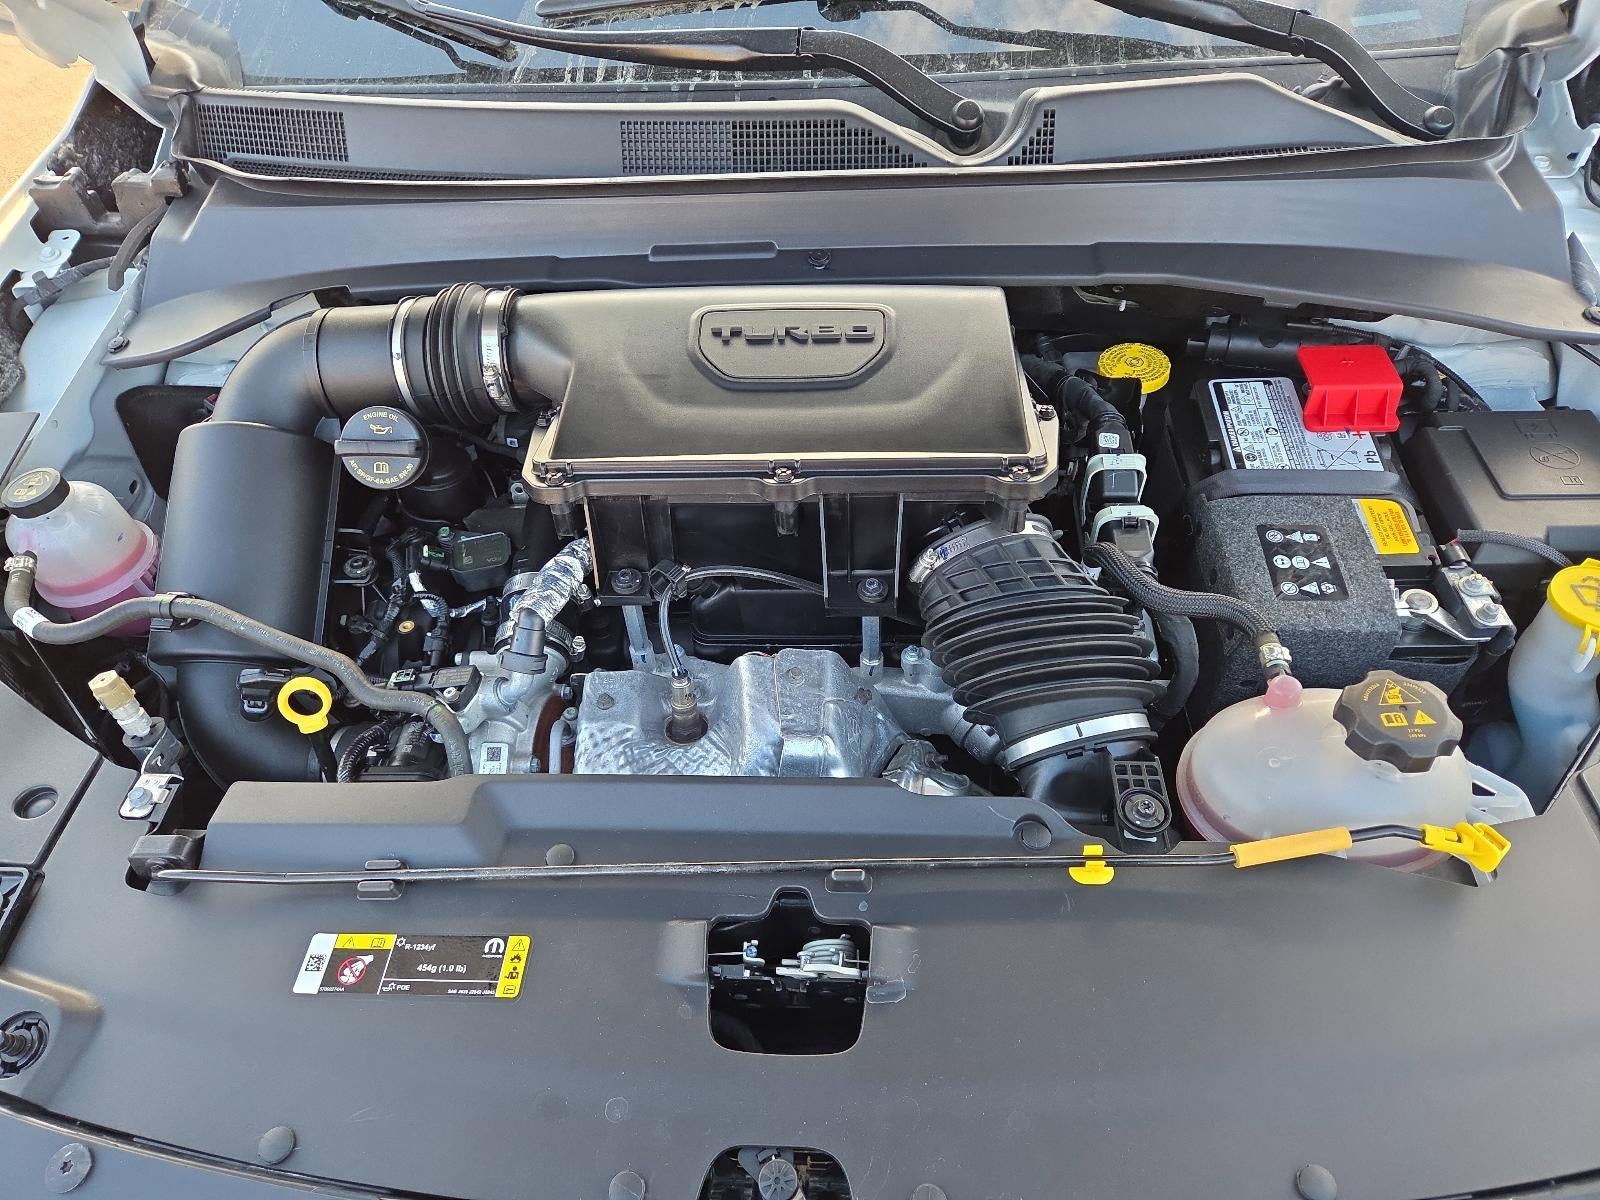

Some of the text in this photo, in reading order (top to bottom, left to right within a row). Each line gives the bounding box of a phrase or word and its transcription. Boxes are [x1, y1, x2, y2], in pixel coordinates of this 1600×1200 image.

[711, 325, 876, 344] TURBO
[363, 411, 399, 423] ENGINE OIL
[1364, 450, 1380, 464] Pb
[404, 943, 436, 952] R-1234yf
[416, 963, 467, 974] 454g (1.0 lb)
